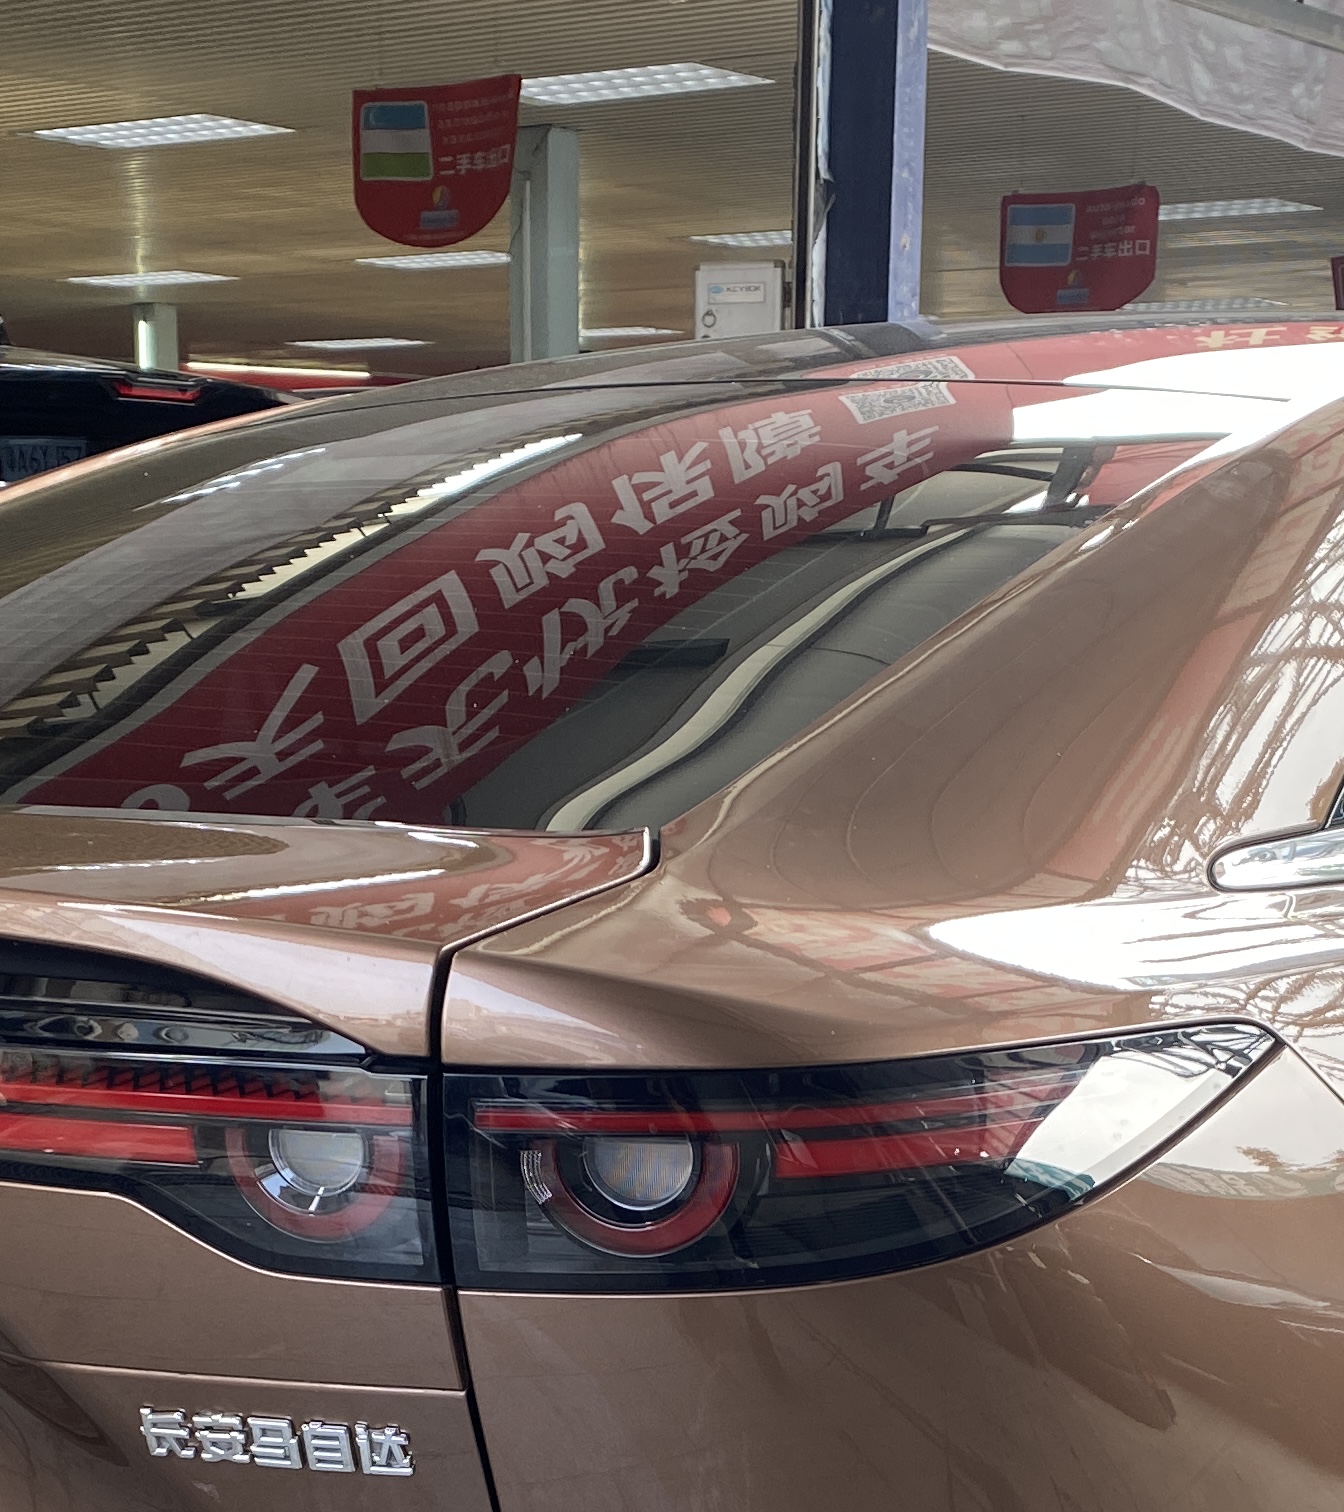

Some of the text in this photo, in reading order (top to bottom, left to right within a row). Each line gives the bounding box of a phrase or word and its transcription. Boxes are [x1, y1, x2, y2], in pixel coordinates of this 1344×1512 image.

[1075, 239, 1151, 261] 二手车出口
[139, 1405, 416, 1477] 长安马自达
